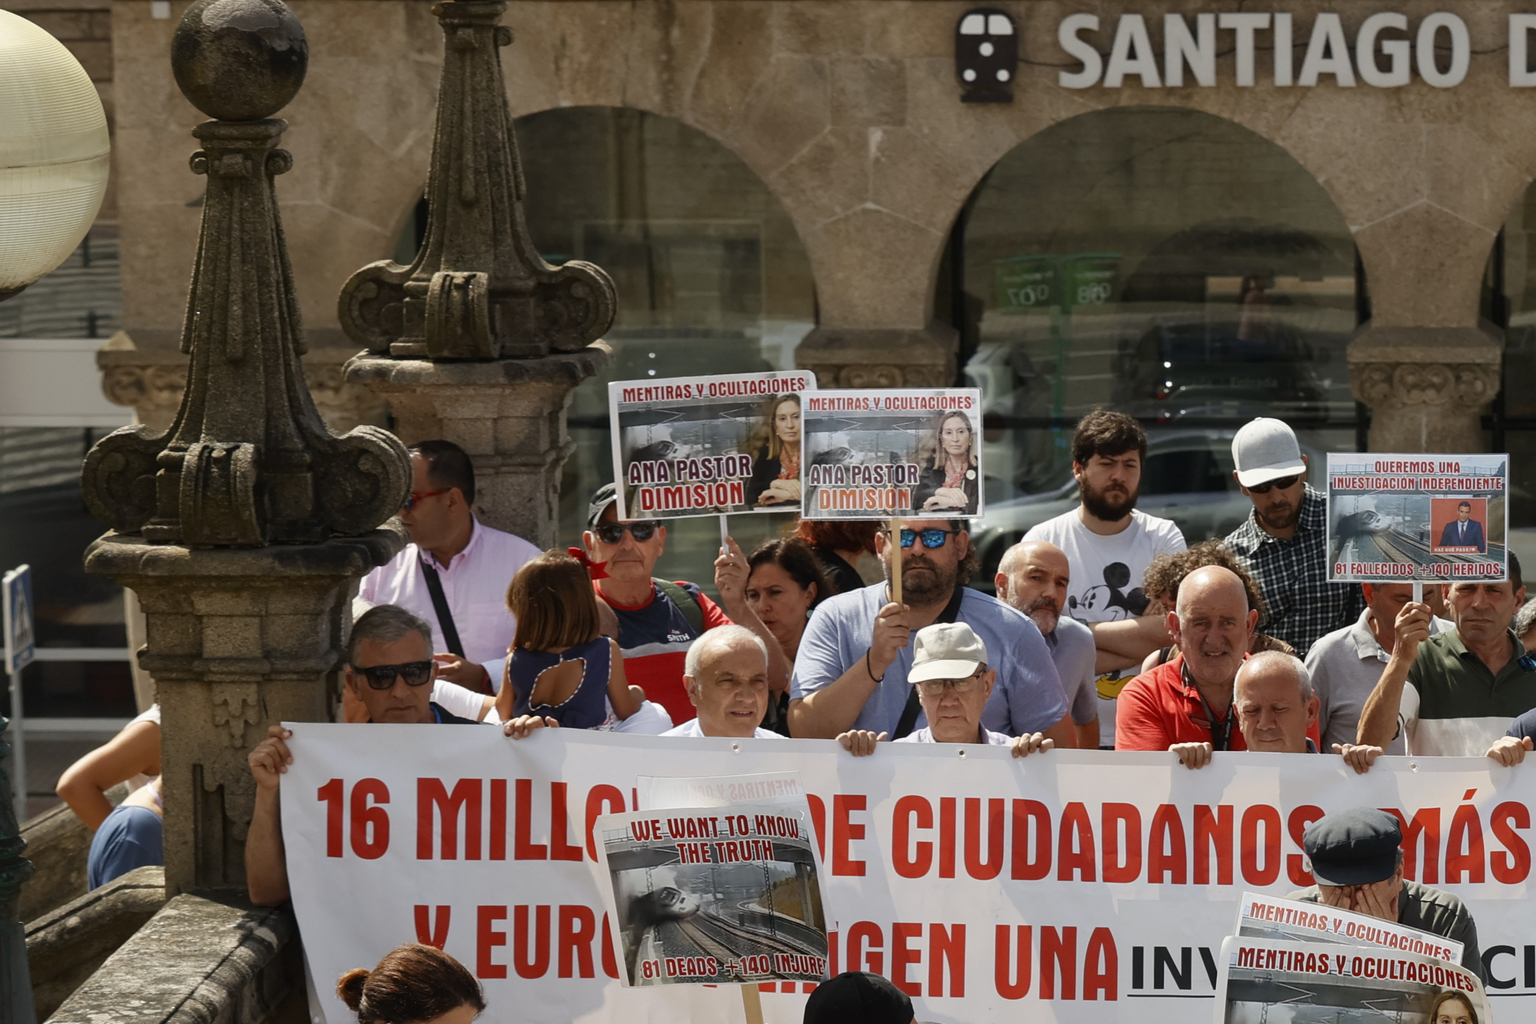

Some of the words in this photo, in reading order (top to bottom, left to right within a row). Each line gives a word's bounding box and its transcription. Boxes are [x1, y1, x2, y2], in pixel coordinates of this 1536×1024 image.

[1057, 12, 1471, 89] SANTIAGO
[623, 384, 692, 403] MENTIRAS
[695, 383, 705, 399] Y
[708, 377, 806, 398] OCULTACIONES
[809, 397, 870, 411] MENTIRAS
[873, 397, 882, 410] Y
[884, 396, 972, 410] OCULTACIONES
[629, 461, 669, 486] ANA
[676, 454, 752, 482] PASTOR
[810, 465, 844, 486] ANA
[851, 464, 919, 486] PASTOR
[1375, 461, 1435, 474] QUEREMOS
[1439, 461, 1460, 474] UNA
[641, 478, 744, 511] DIMISIÓN
[1333, 475, 1415, 490] INVESTIGACIÓN
[1419, 478, 1502, 490] INDEPENDIENTE
[819, 485, 911, 510] DIMISIÓN
[1335, 563, 1347, 575] 81
[1351, 563, 1414, 575] FALLECIDOS
[1453, 563, 1500, 575] HERIDOS
[317, 777, 390, 860] 16
[892, 794, 1326, 887] CIUDADANOS
[1378, 788, 1532, 885] MÁS
[631, 819, 662, 842] WE
[667, 817, 718, 839] WANT
[725, 815, 749, 836] TO
[755, 815, 799, 839] KNOW
[677, 841, 711, 863] THE
[716, 840, 775, 863] TRUTH
[1250, 902, 1328, 930] MENTIRAS
[1333, 918, 1342, 933] Y
[1346, 921, 1451, 961] OCULTACIONES
[642, 961, 661, 979] 81
[666, 957, 717, 977] DEADS
[995, 924, 1118, 1001] UNA
[1237, 947, 1329, 974] MENTIRAS
[1352, 956, 1474, 993] OCULTACIONES
